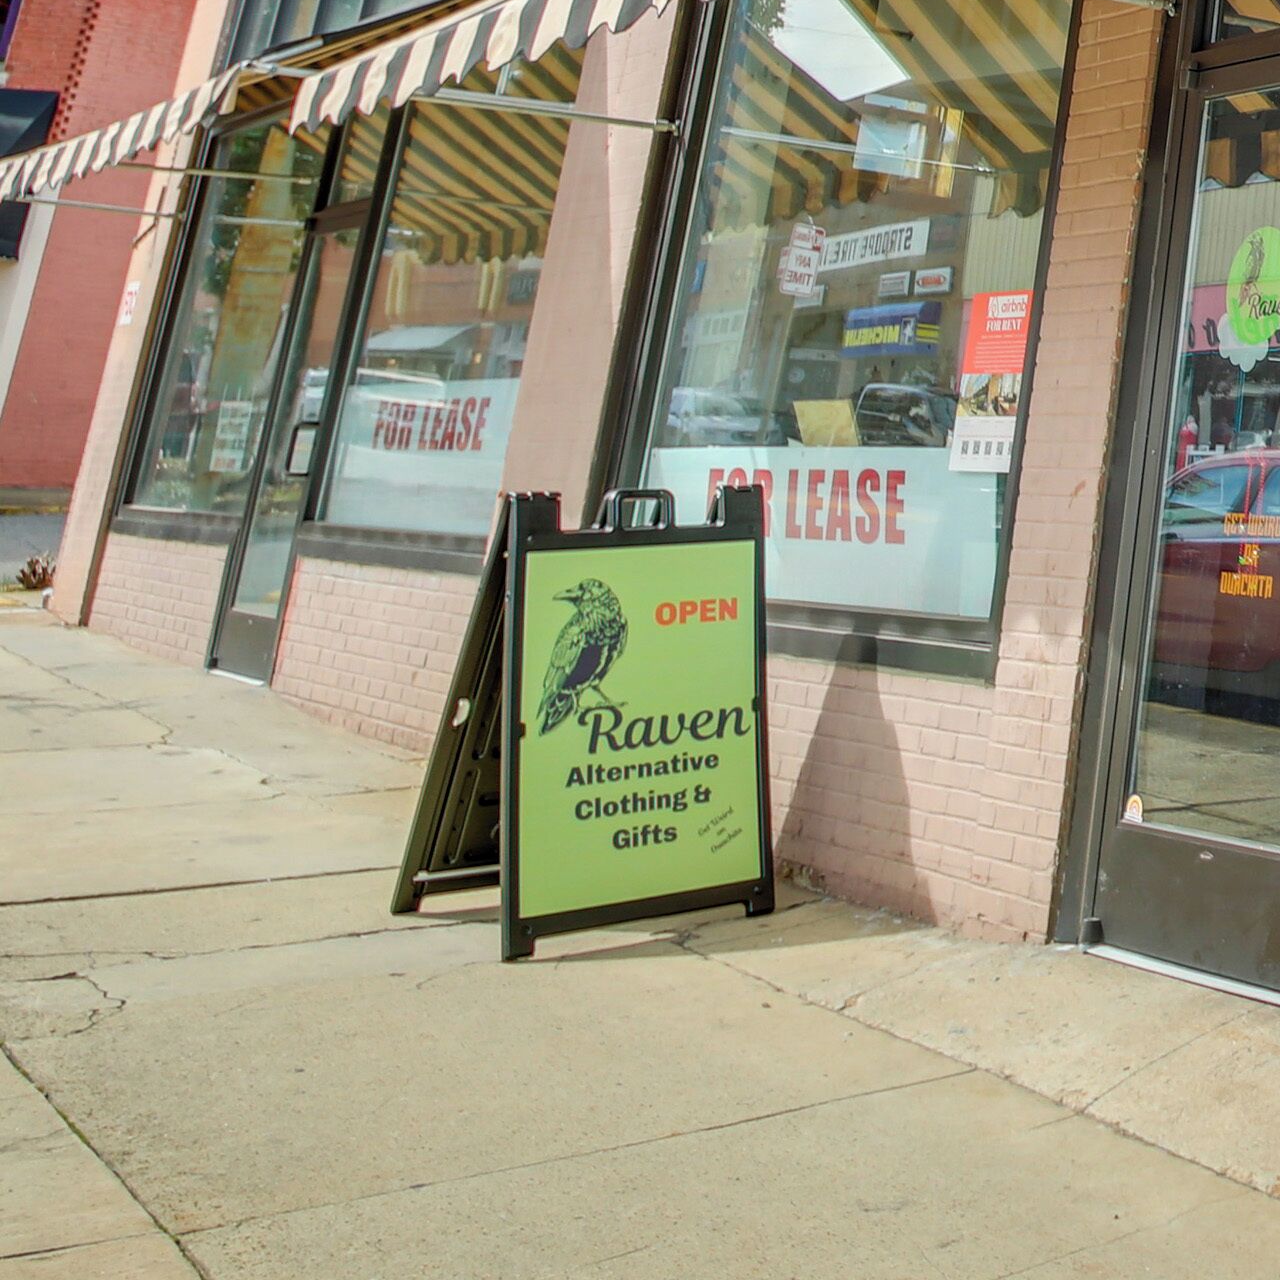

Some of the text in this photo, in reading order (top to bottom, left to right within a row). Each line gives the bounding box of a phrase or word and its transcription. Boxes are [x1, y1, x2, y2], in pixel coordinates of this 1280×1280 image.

[418, 396, 491, 451] LEASE
[785, 468, 906, 544] LEASE
[655, 597, 739, 626] OPEN
[577, 705, 752, 754] Raven
[565, 752, 720, 788] Alternative
[574, 783, 712, 821] Clothing &
[611, 823, 679, 851] Gifts
